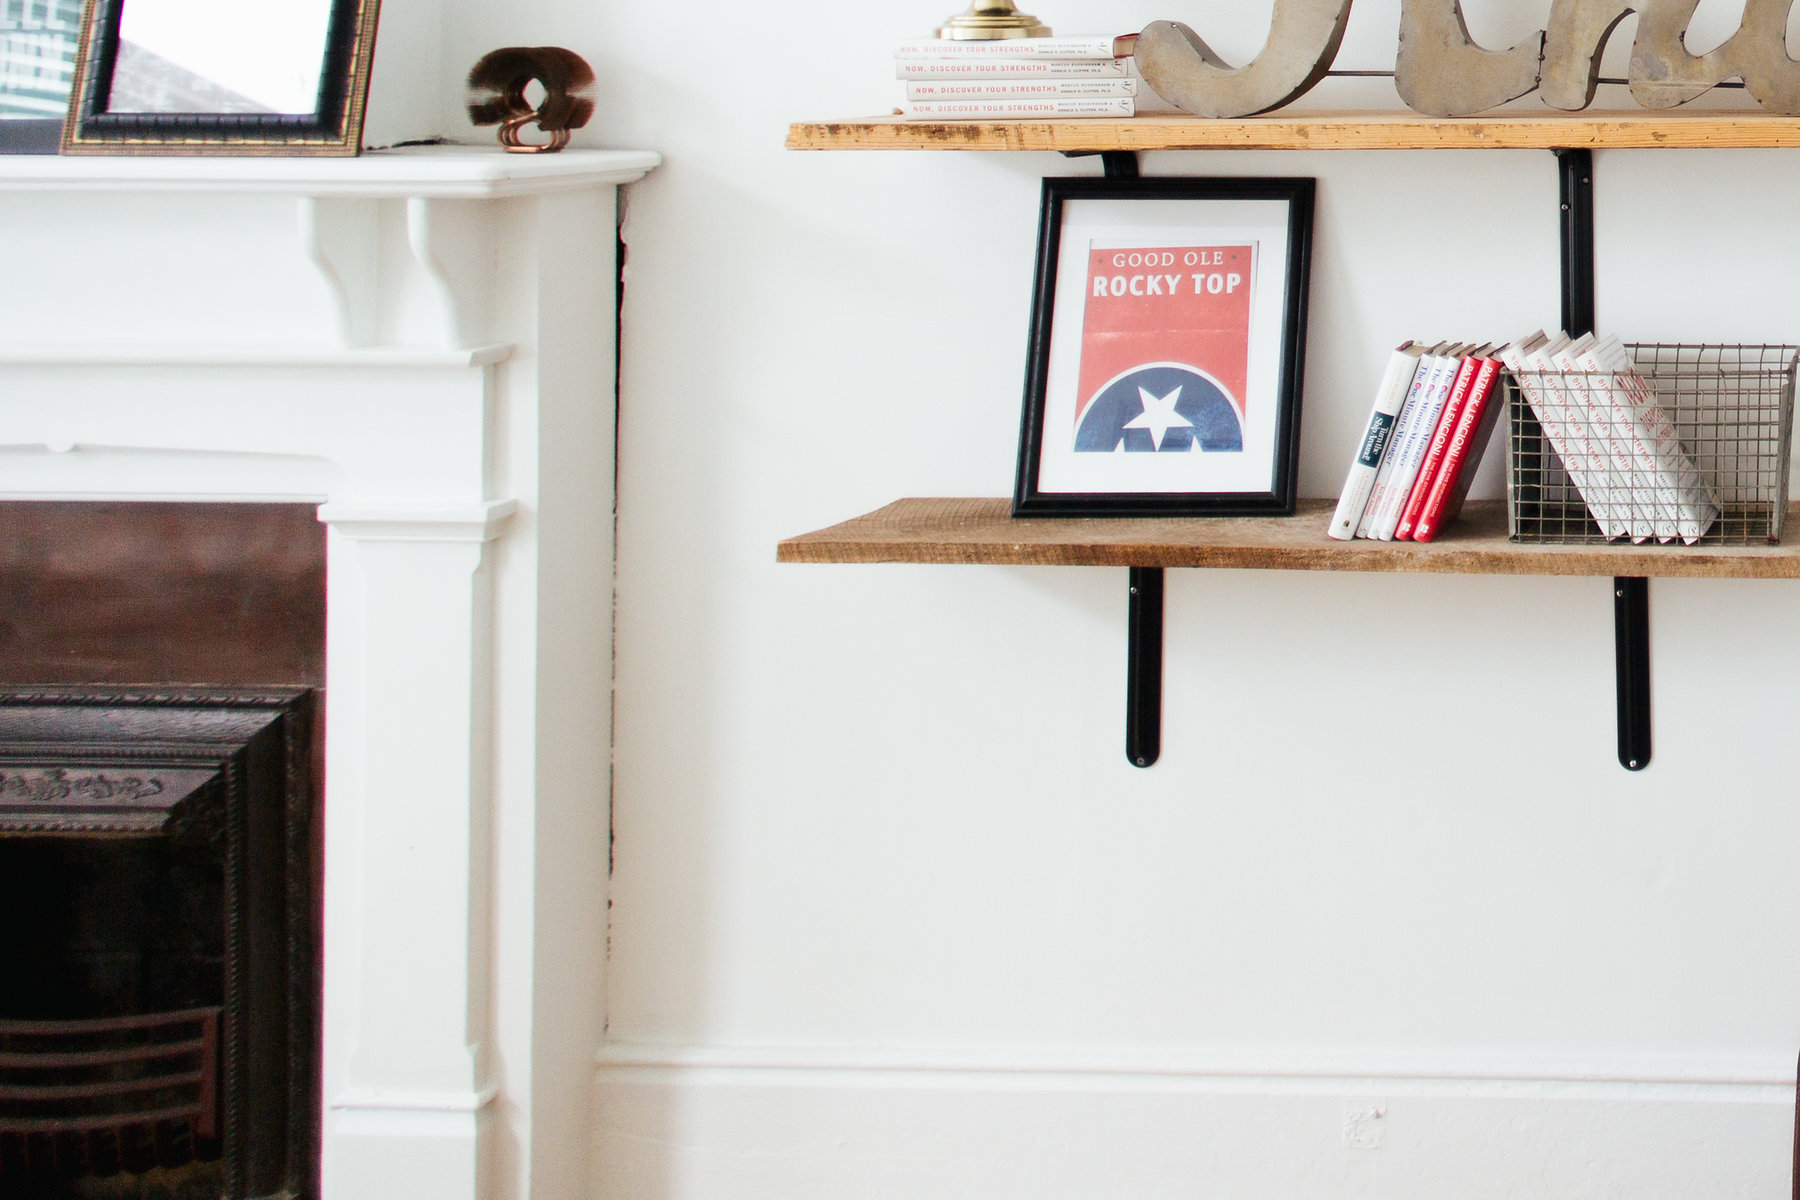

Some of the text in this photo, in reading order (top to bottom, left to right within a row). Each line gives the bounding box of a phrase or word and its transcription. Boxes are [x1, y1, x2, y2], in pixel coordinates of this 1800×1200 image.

[975, 64, 997, 72] YOUR
[1000, 64, 1047, 72] STRENGTHS
[985, 86, 1007, 94] YOUR
[1011, 85, 1058, 93] STRENGTHS
[982, 104, 1005, 112] YOUR
[1007, 104, 1055, 112] STRENGTHS
[1112, 251, 1224, 268] GOOD OLE
[1093, 273, 1241, 297] ROCKY TOP
[1417, 365, 1428, 380] The
[1454, 365, 1473, 405] PATRICK
[1472, 365, 1493, 407] PATRICK
[1400, 400, 1416, 429] Minute
[1433, 408, 1456, 456] LENCIONI
[1451, 409, 1476, 458] LENCIONI
[1386, 430, 1404, 466] Manager
